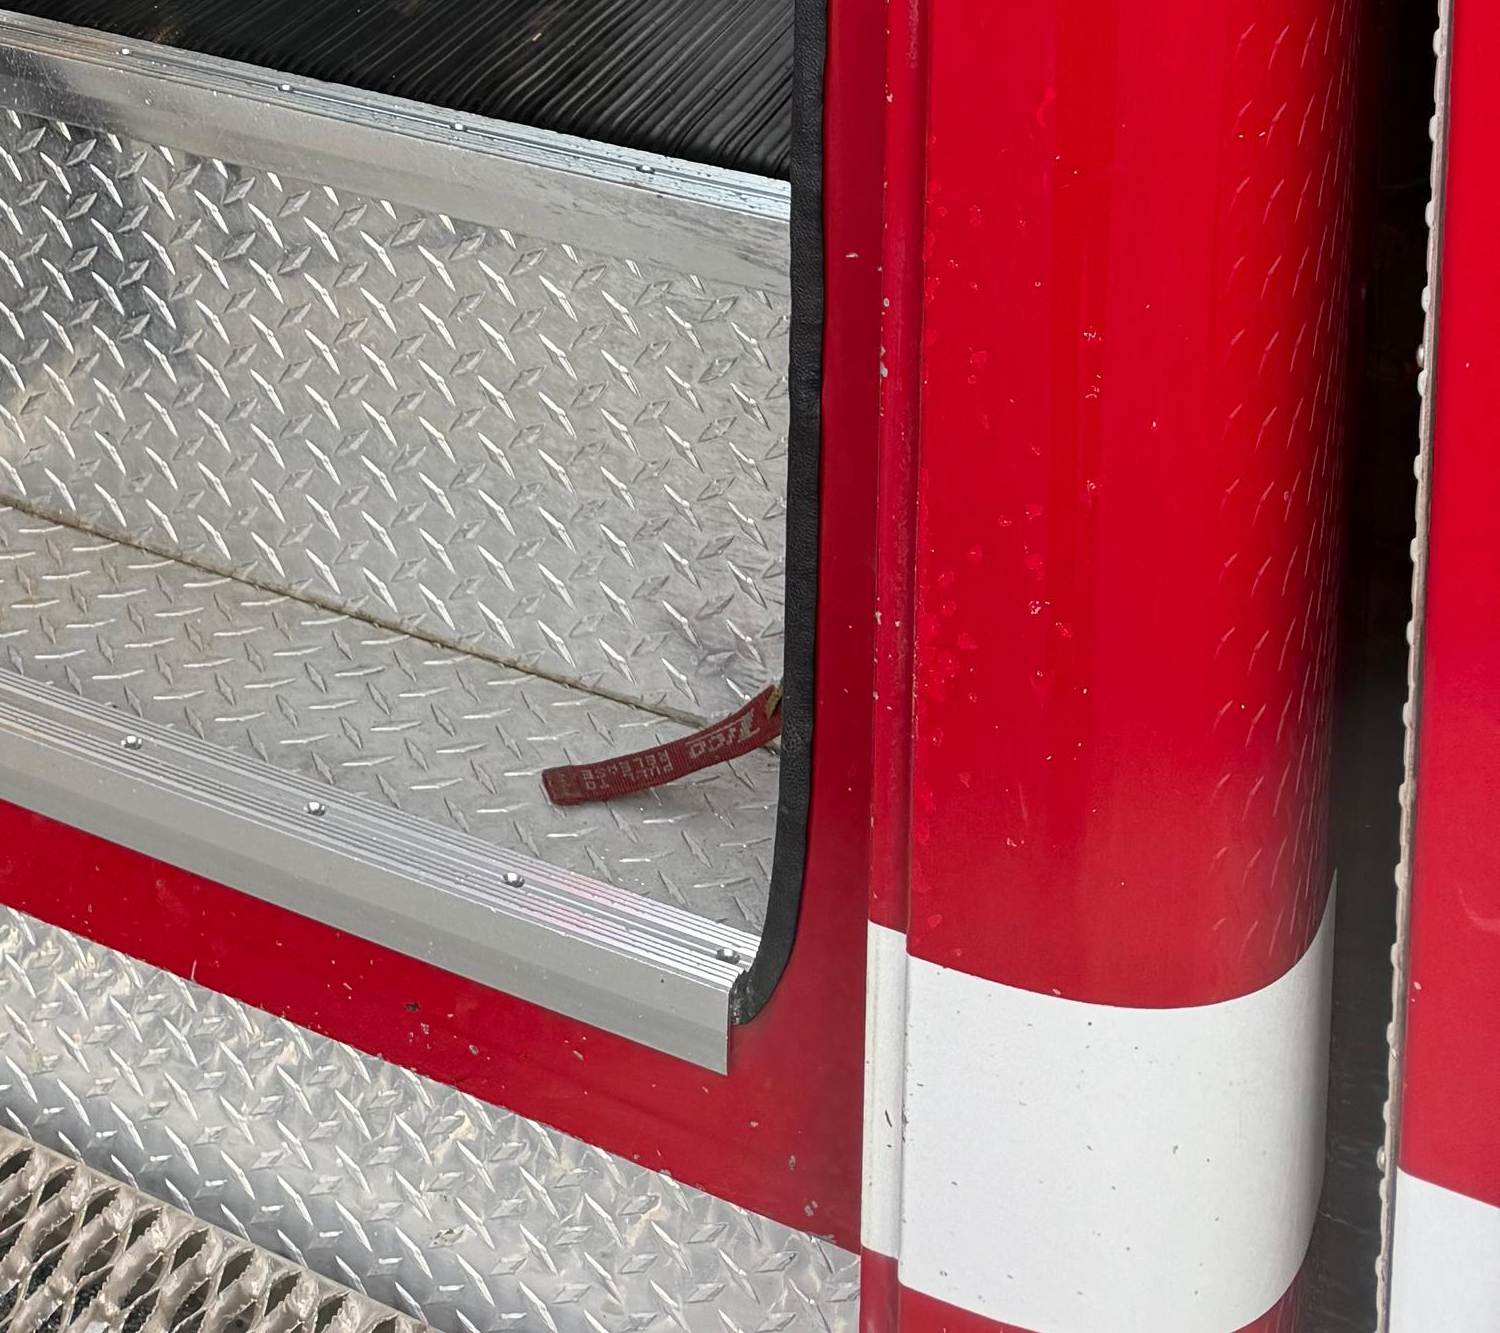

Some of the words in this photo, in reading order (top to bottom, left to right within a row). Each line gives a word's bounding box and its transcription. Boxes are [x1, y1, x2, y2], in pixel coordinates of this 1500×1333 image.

[581, 749, 672, 783] RELEASE
[623, 762, 674, 783] PULL
[585, 777, 610, 790] TO
